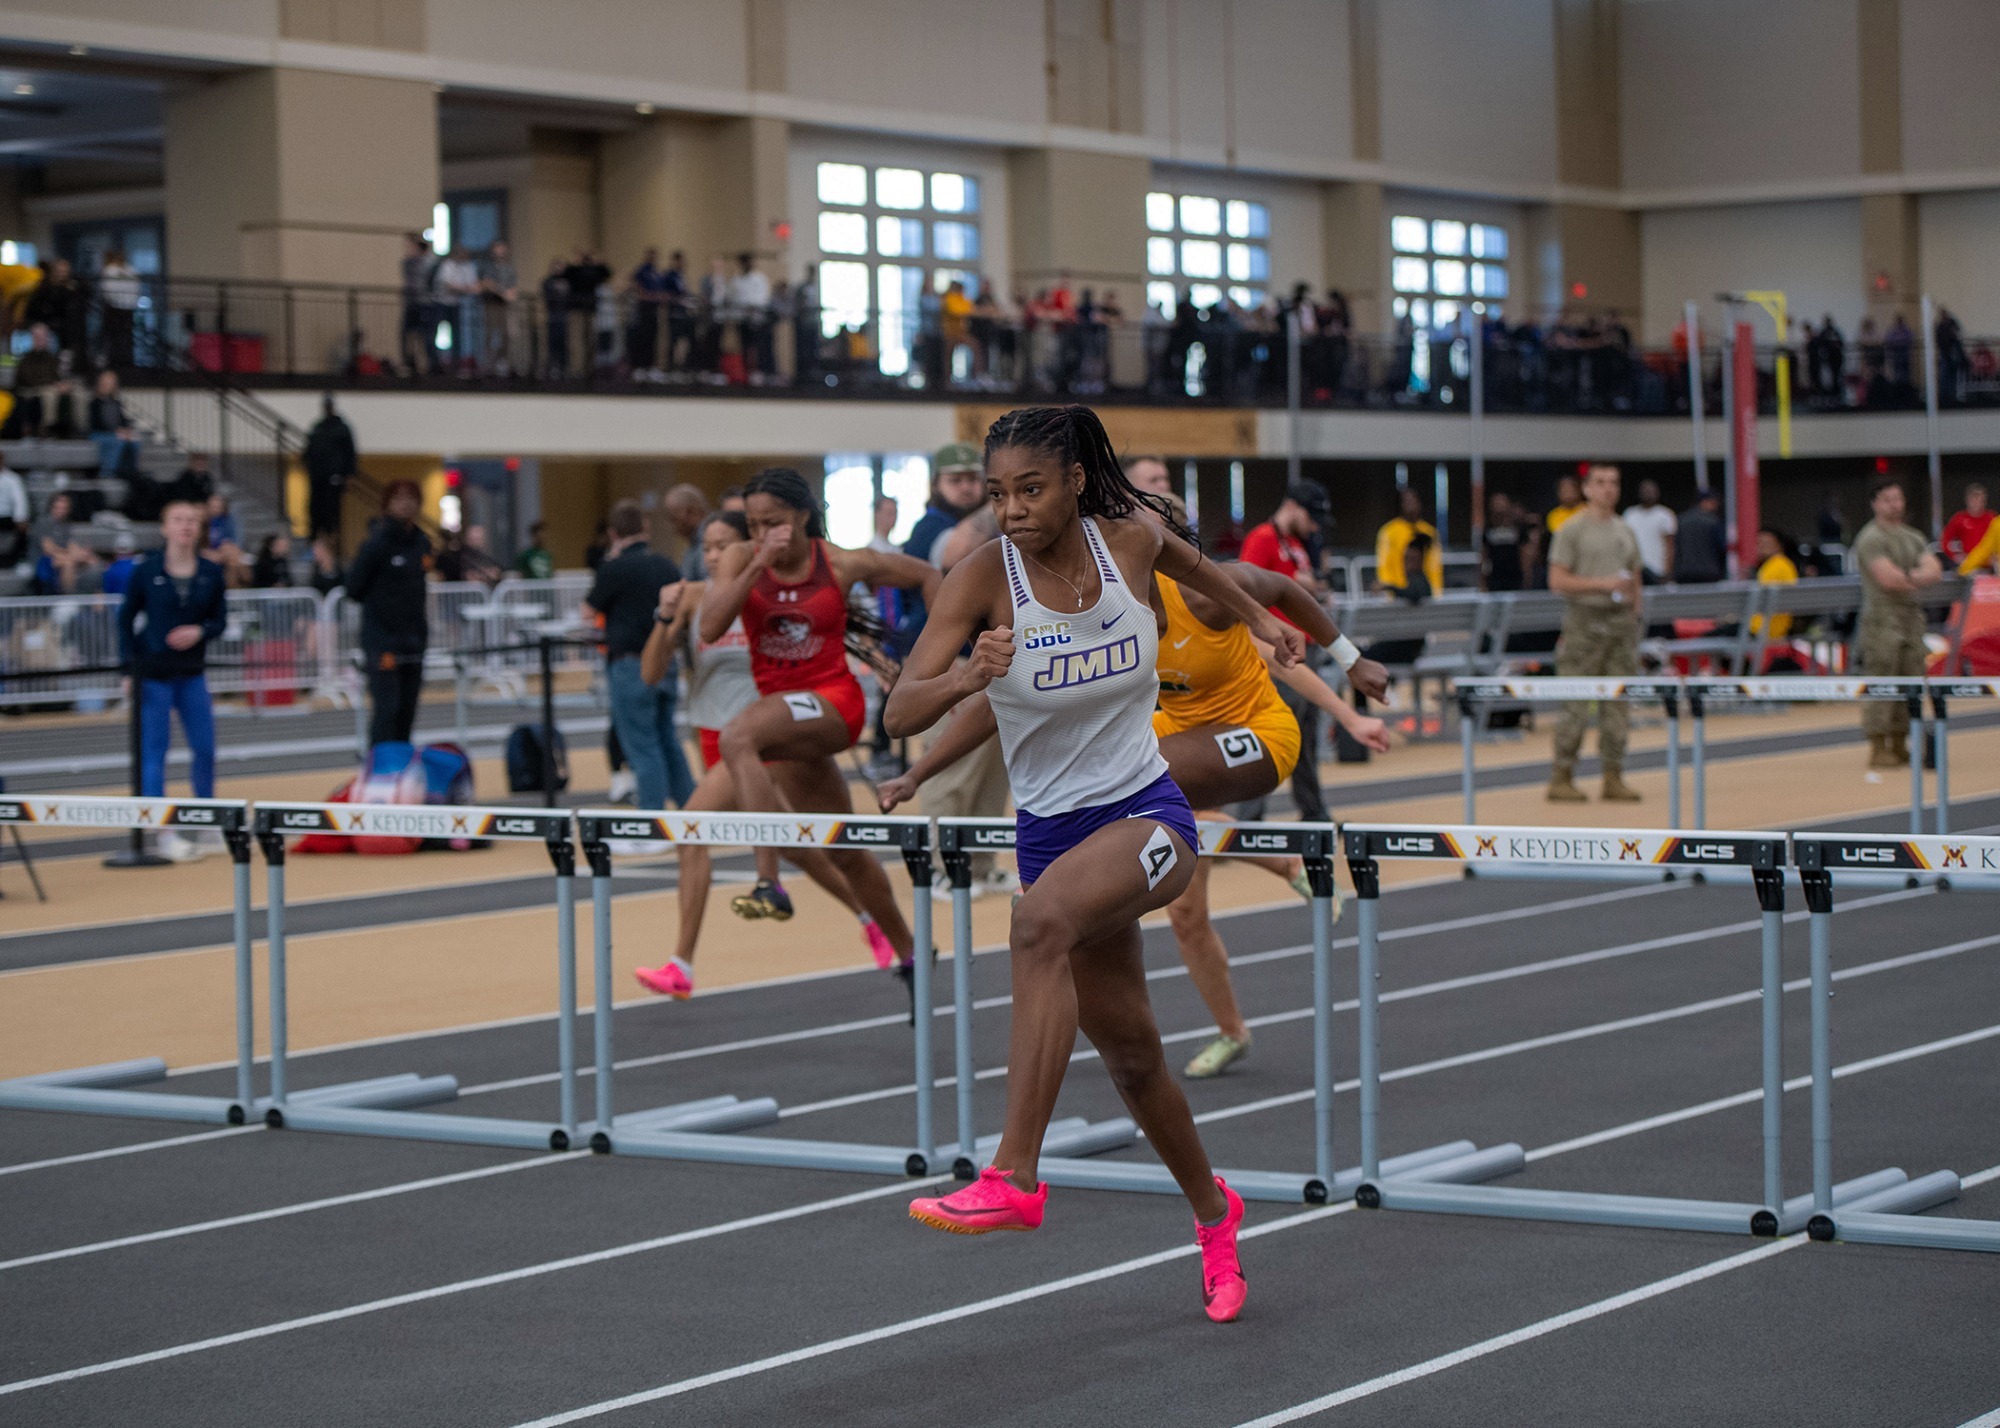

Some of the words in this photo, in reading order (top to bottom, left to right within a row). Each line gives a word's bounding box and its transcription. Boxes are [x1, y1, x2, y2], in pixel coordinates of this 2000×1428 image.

[1023, 622, 1072, 650] SBC
[1034, 636, 1140, 691] JMU
[1223, 733, 1258, 759] 5
[66, 807, 132, 821] KEYDETS
[177, 808, 214, 823] UCS
[283, 813, 321, 827] UCS
[372, 814, 446, 833] KEYDETS
[496, 820, 536, 833] UCS
[611, 821, 652, 836] UCS
[709, 823, 790, 842] KEYDETS
[846, 827, 890, 841] UCS
[975, 830, 1017, 844] UCS
[1241, 835, 1288, 848] UCS
[1386, 837, 1435, 852] UCS
[1509, 838, 1610, 861] KEYDETS
[1683, 844, 1735, 859] UCS
[1841, 847, 1896, 863] UCS
[1148, 844, 1173, 879] 4
